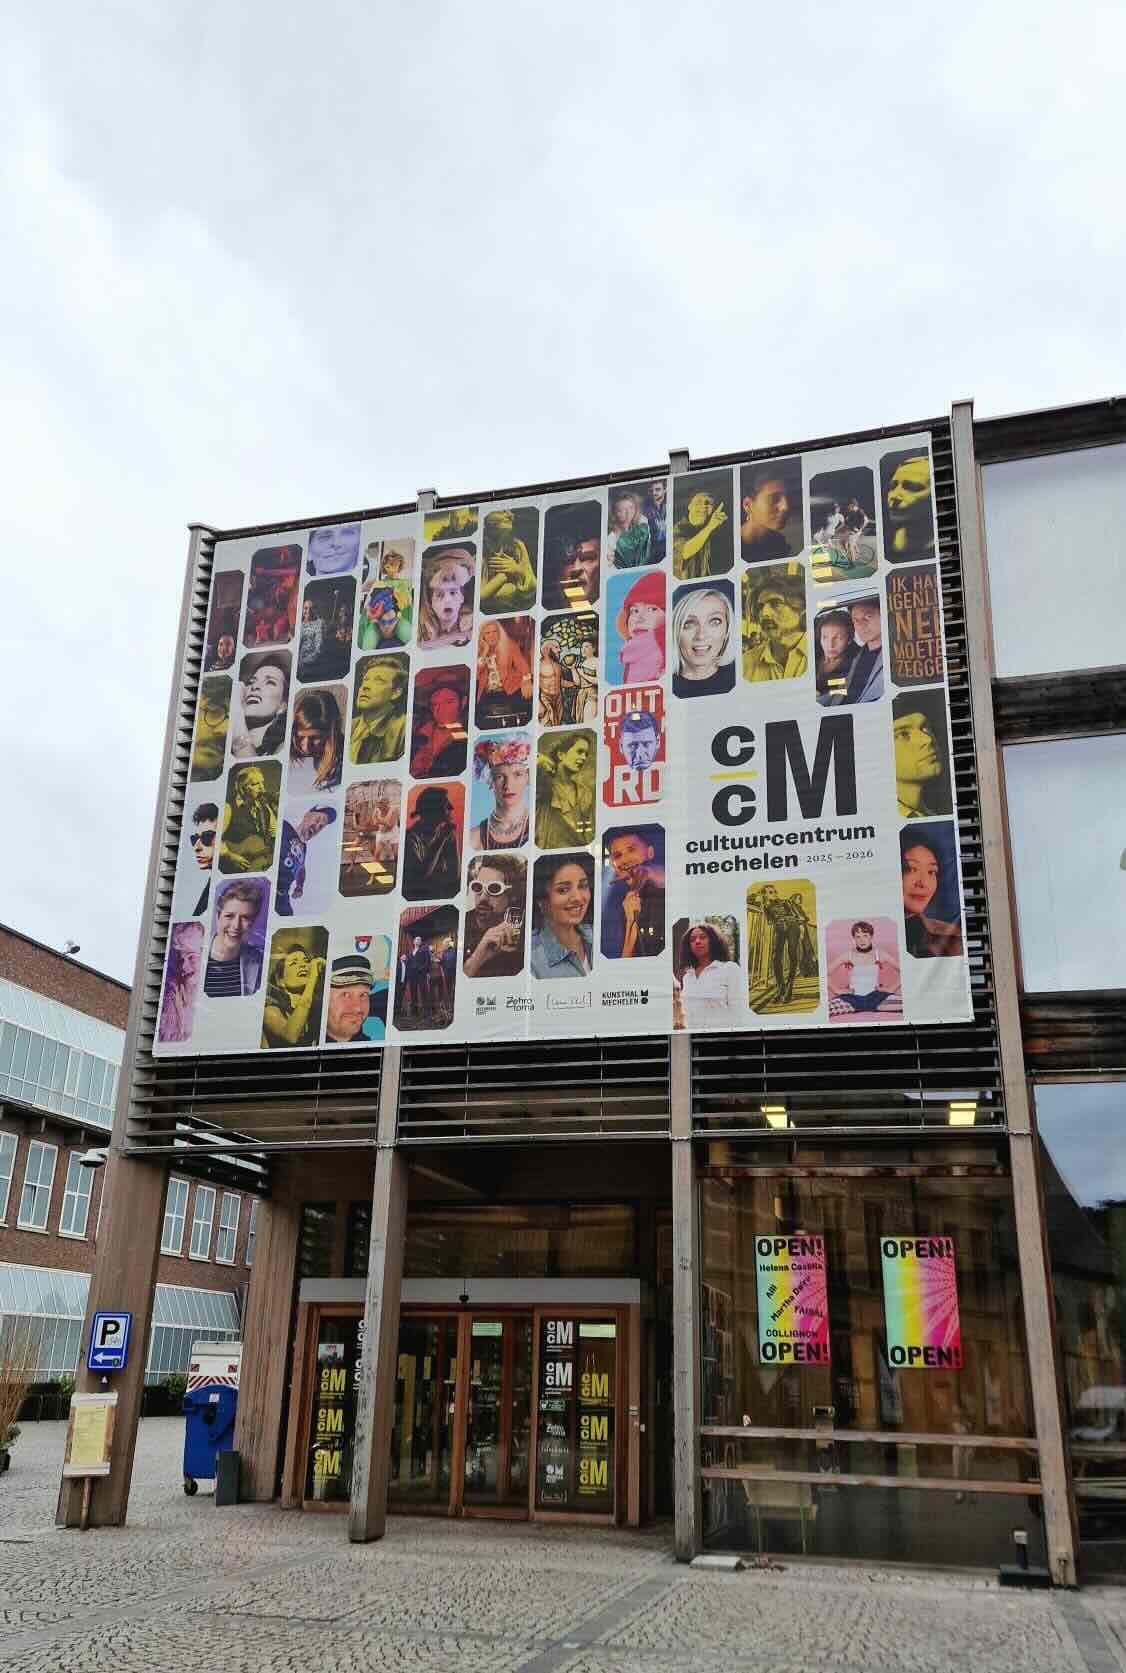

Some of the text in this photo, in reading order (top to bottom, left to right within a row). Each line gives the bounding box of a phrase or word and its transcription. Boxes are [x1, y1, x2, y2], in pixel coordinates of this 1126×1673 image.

[685, 824, 876, 854] cultuurcentrum
[685, 851, 798, 876] mechelen
[806, 854, 833, 864] 2025
[601, 990, 638, 999] KUNSTHAL
[601, 998, 639, 1006] MECHELEN
[757, 1238, 823, 1256] OPEN!
[882, 1239, 952, 1259] OPEN!
[101, 1320, 120, 1346] P
[761, 1341, 829, 1361] OPEN!
[889, 1345, 961, 1367] OPEN!
